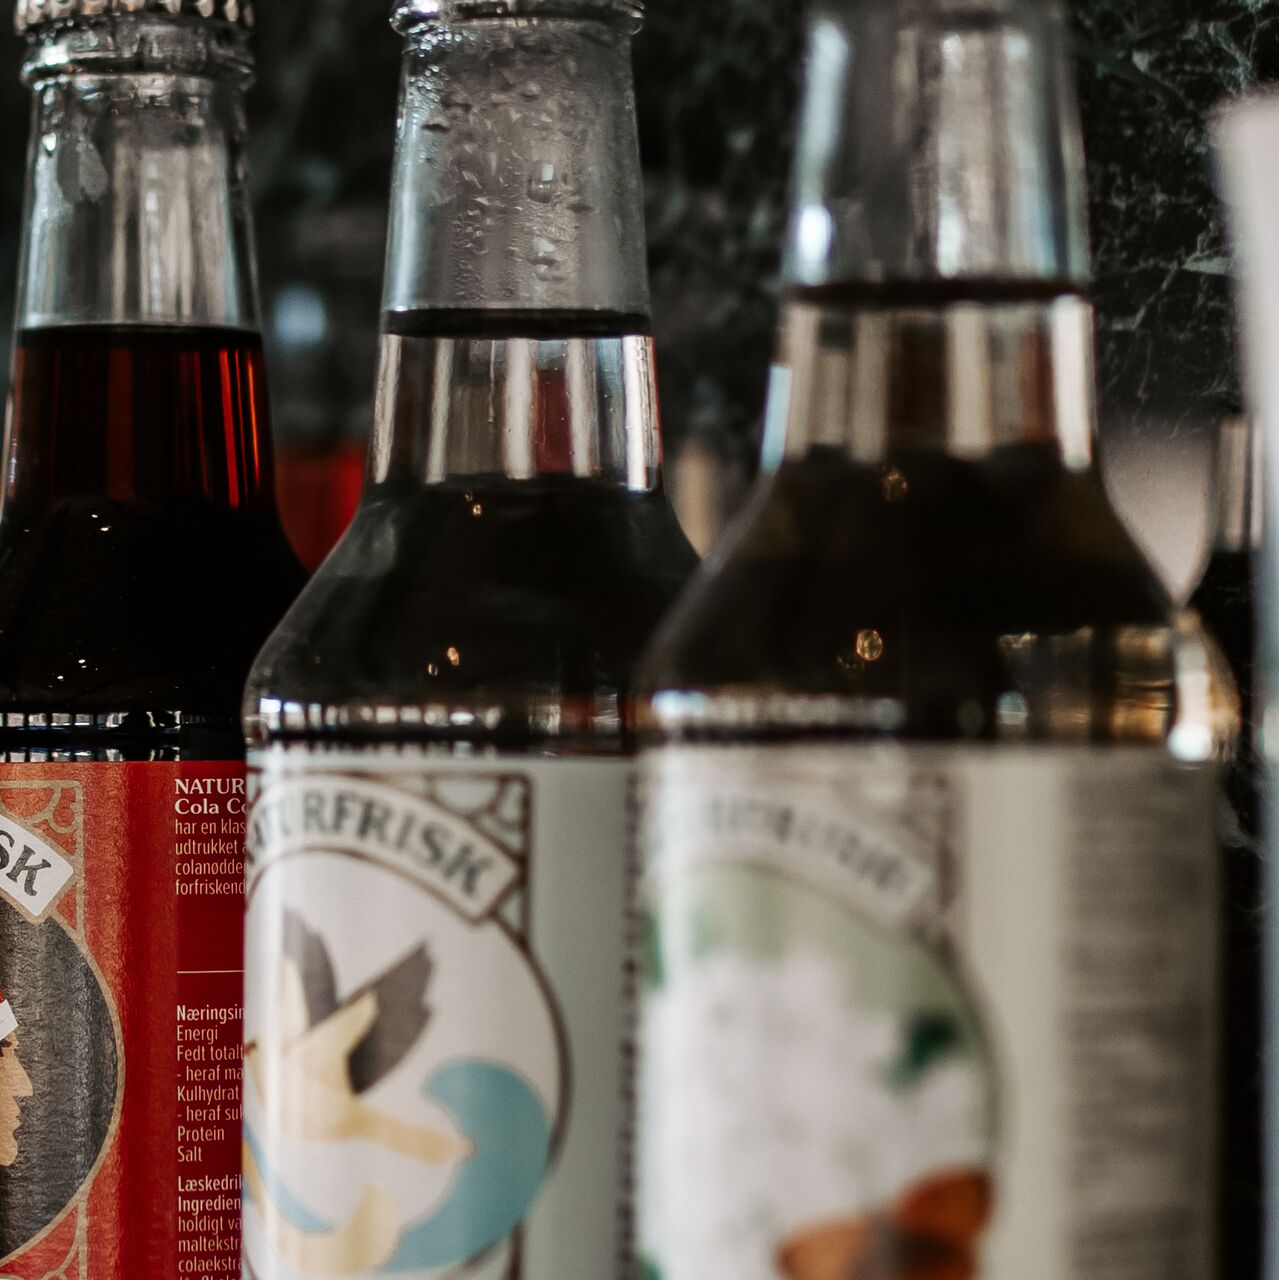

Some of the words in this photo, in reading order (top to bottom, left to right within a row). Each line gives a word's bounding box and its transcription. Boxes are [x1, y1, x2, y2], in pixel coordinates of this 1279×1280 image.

[174, 778, 245, 795] NATUR
[174, 798, 220, 815] Cola
[175, 818, 197, 835] har
[200, 822, 217, 835] en
[221, 817, 246, 834] klas
[175, 838, 238, 855] udtrukket
[176, 1024, 218, 1045] Energi
[176, 1044, 206, 1062] Fedt
[210, 1043, 244, 1061] totalt
[186, 1064, 221, 1081] heraf
[177, 1084, 239, 1105] Kulhydrat
[186, 1104, 221, 1122] heraf
[177, 1124, 225, 1142] Protein
[177, 1145, 203, 1163] Salt
[178, 1215, 224, 1236] holdigt
